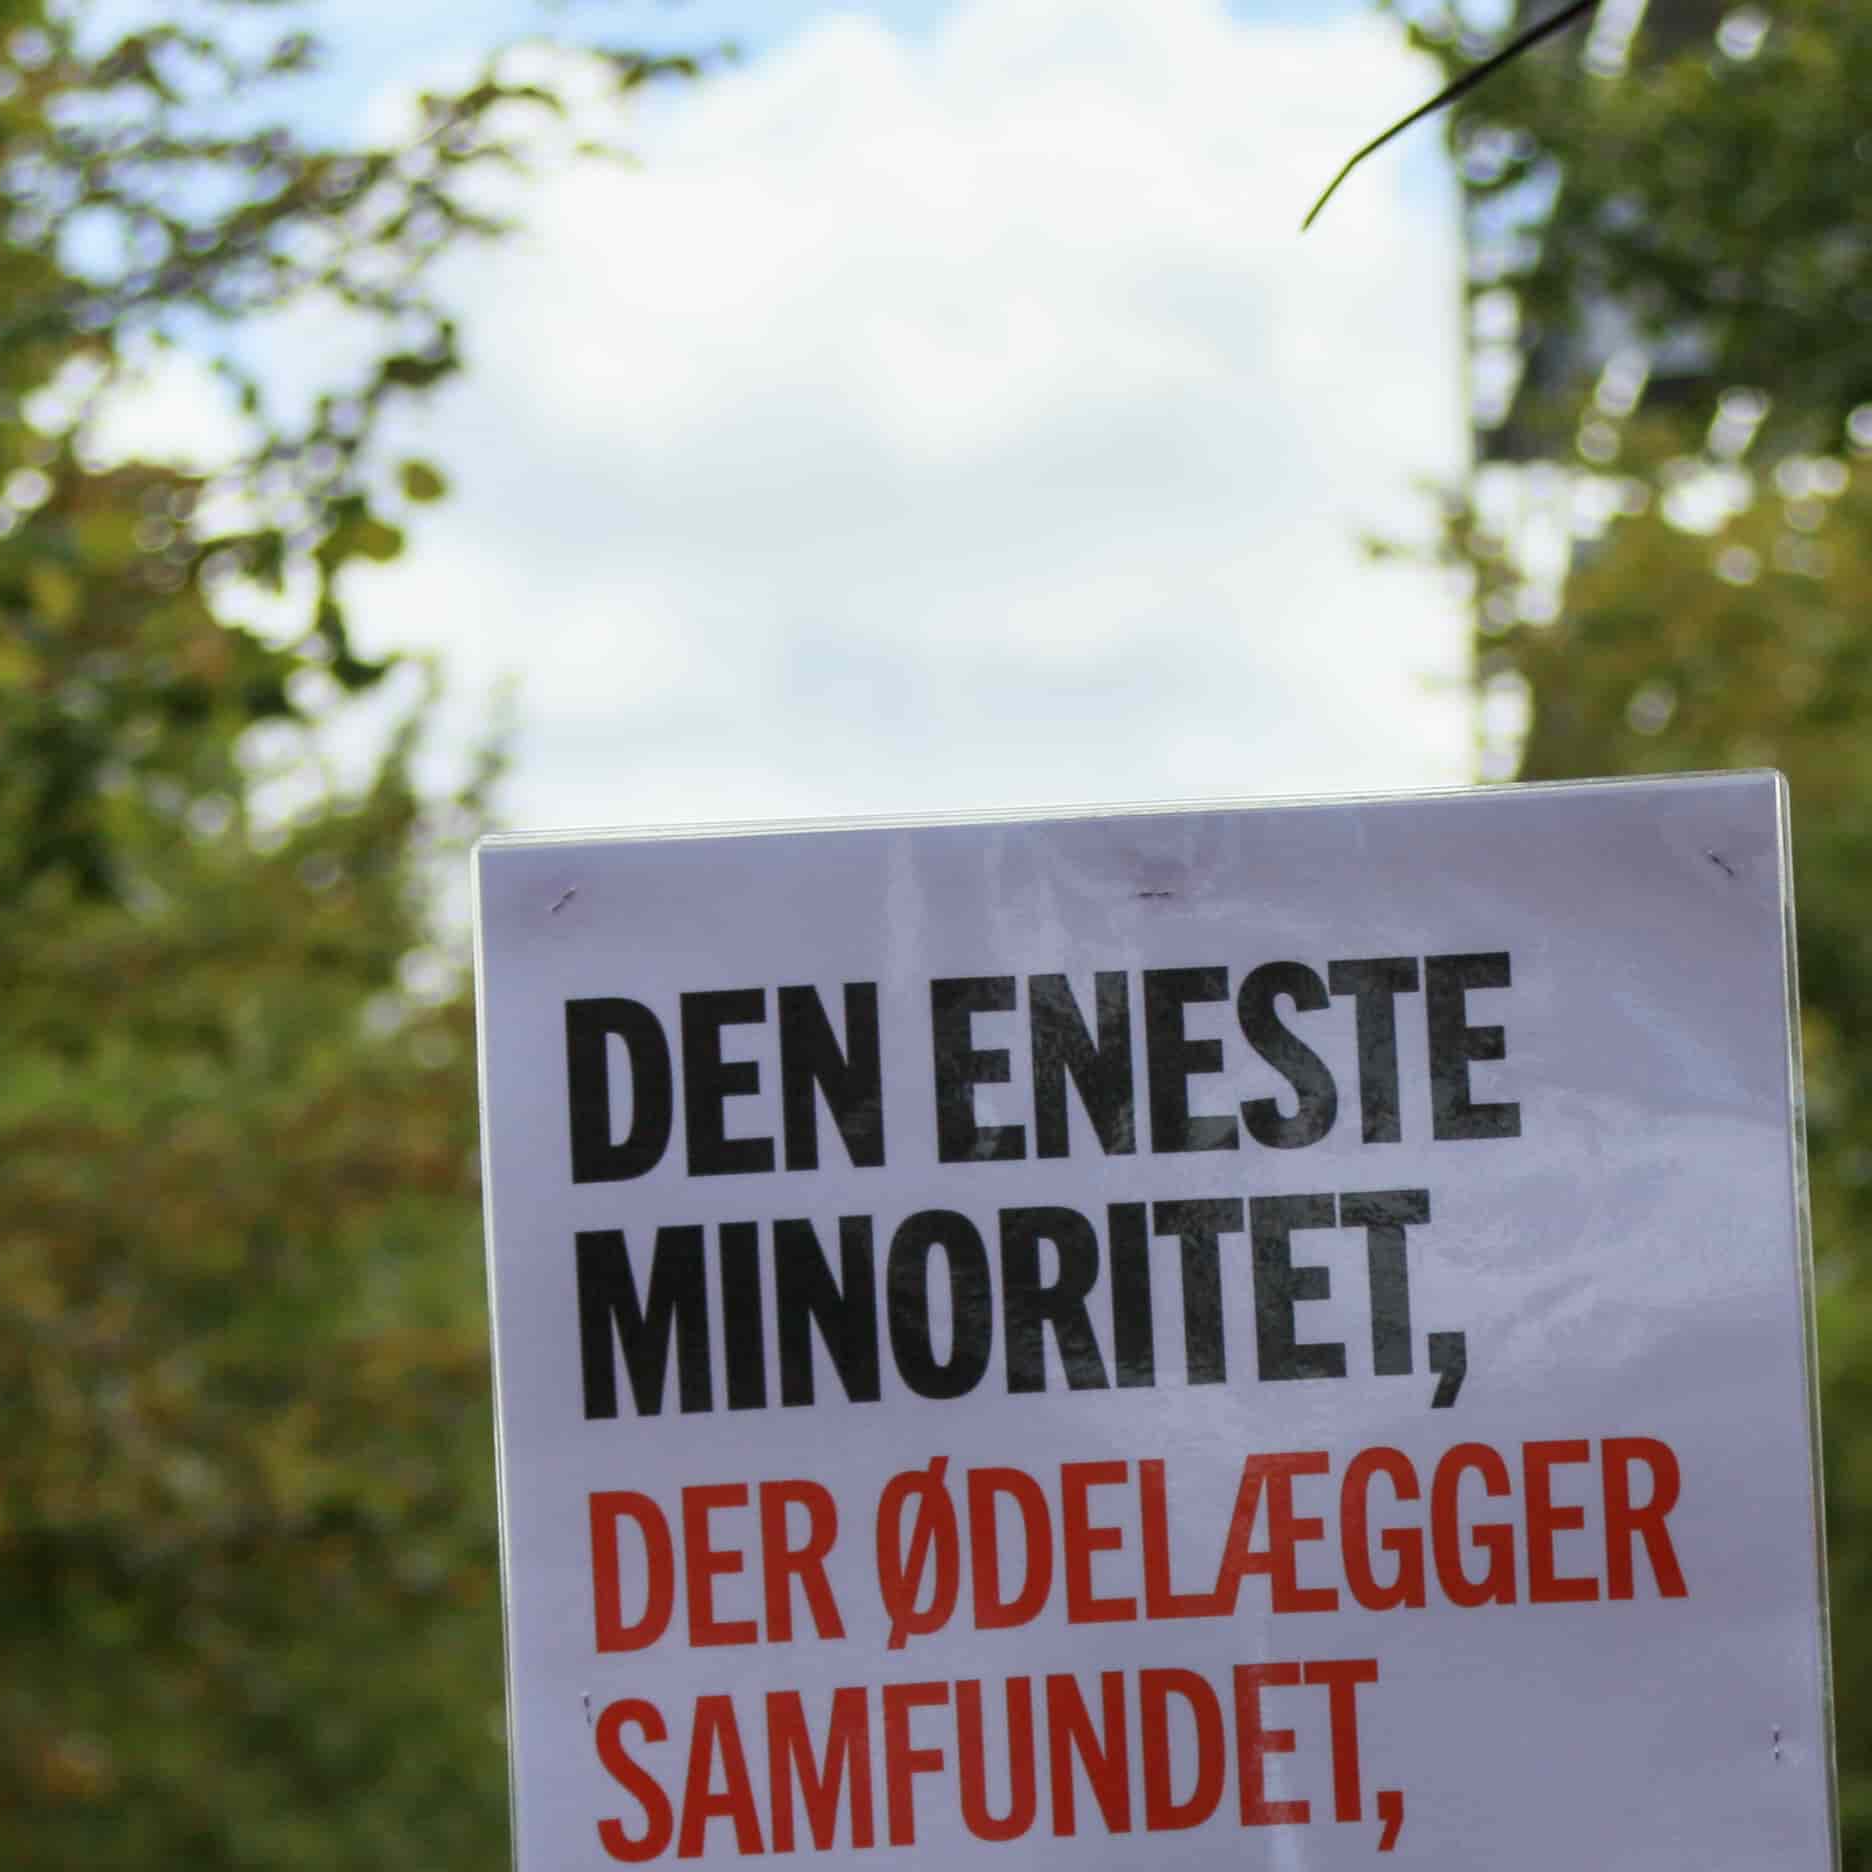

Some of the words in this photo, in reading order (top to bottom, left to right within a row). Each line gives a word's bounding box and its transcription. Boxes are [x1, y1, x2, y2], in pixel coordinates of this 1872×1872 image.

[565, 981, 886, 1185] DEN
[929, 951, 1522, 1165] ENESTE
[574, 1189, 1468, 1421] MINORITET,
[587, 1479, 846, 1655] DER
[876, 1437, 1688, 1650] ØDELÆGGER
[595, 1659, 1404, 1863] SAMFUNDET,
